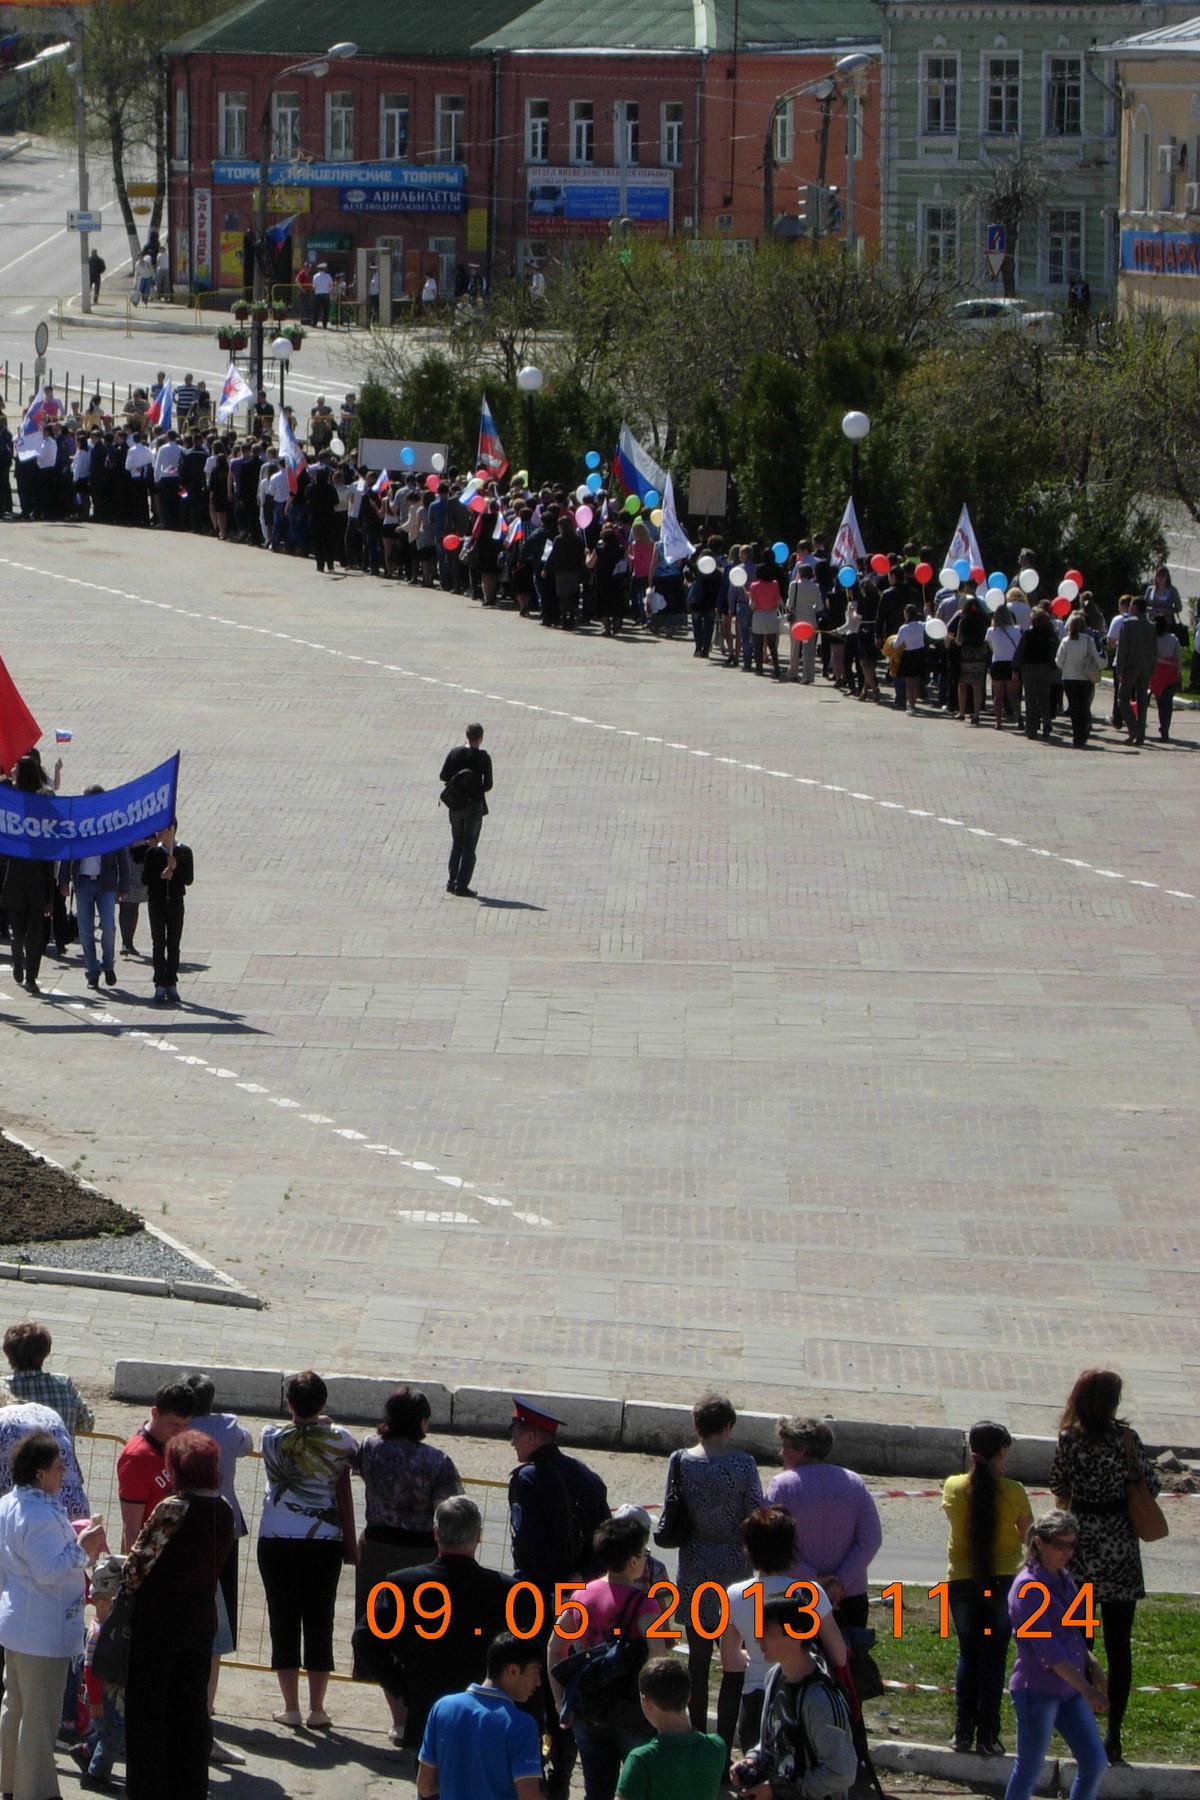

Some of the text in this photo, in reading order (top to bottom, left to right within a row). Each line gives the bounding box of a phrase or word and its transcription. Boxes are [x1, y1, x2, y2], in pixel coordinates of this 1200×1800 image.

[288, 169, 392, 181] КАНЦЕЛЯРСКИЕ
[403, 171, 458, 183] ТОВАРЫ
[373, 191, 461, 202] АВИАБИЛЕТЫ
